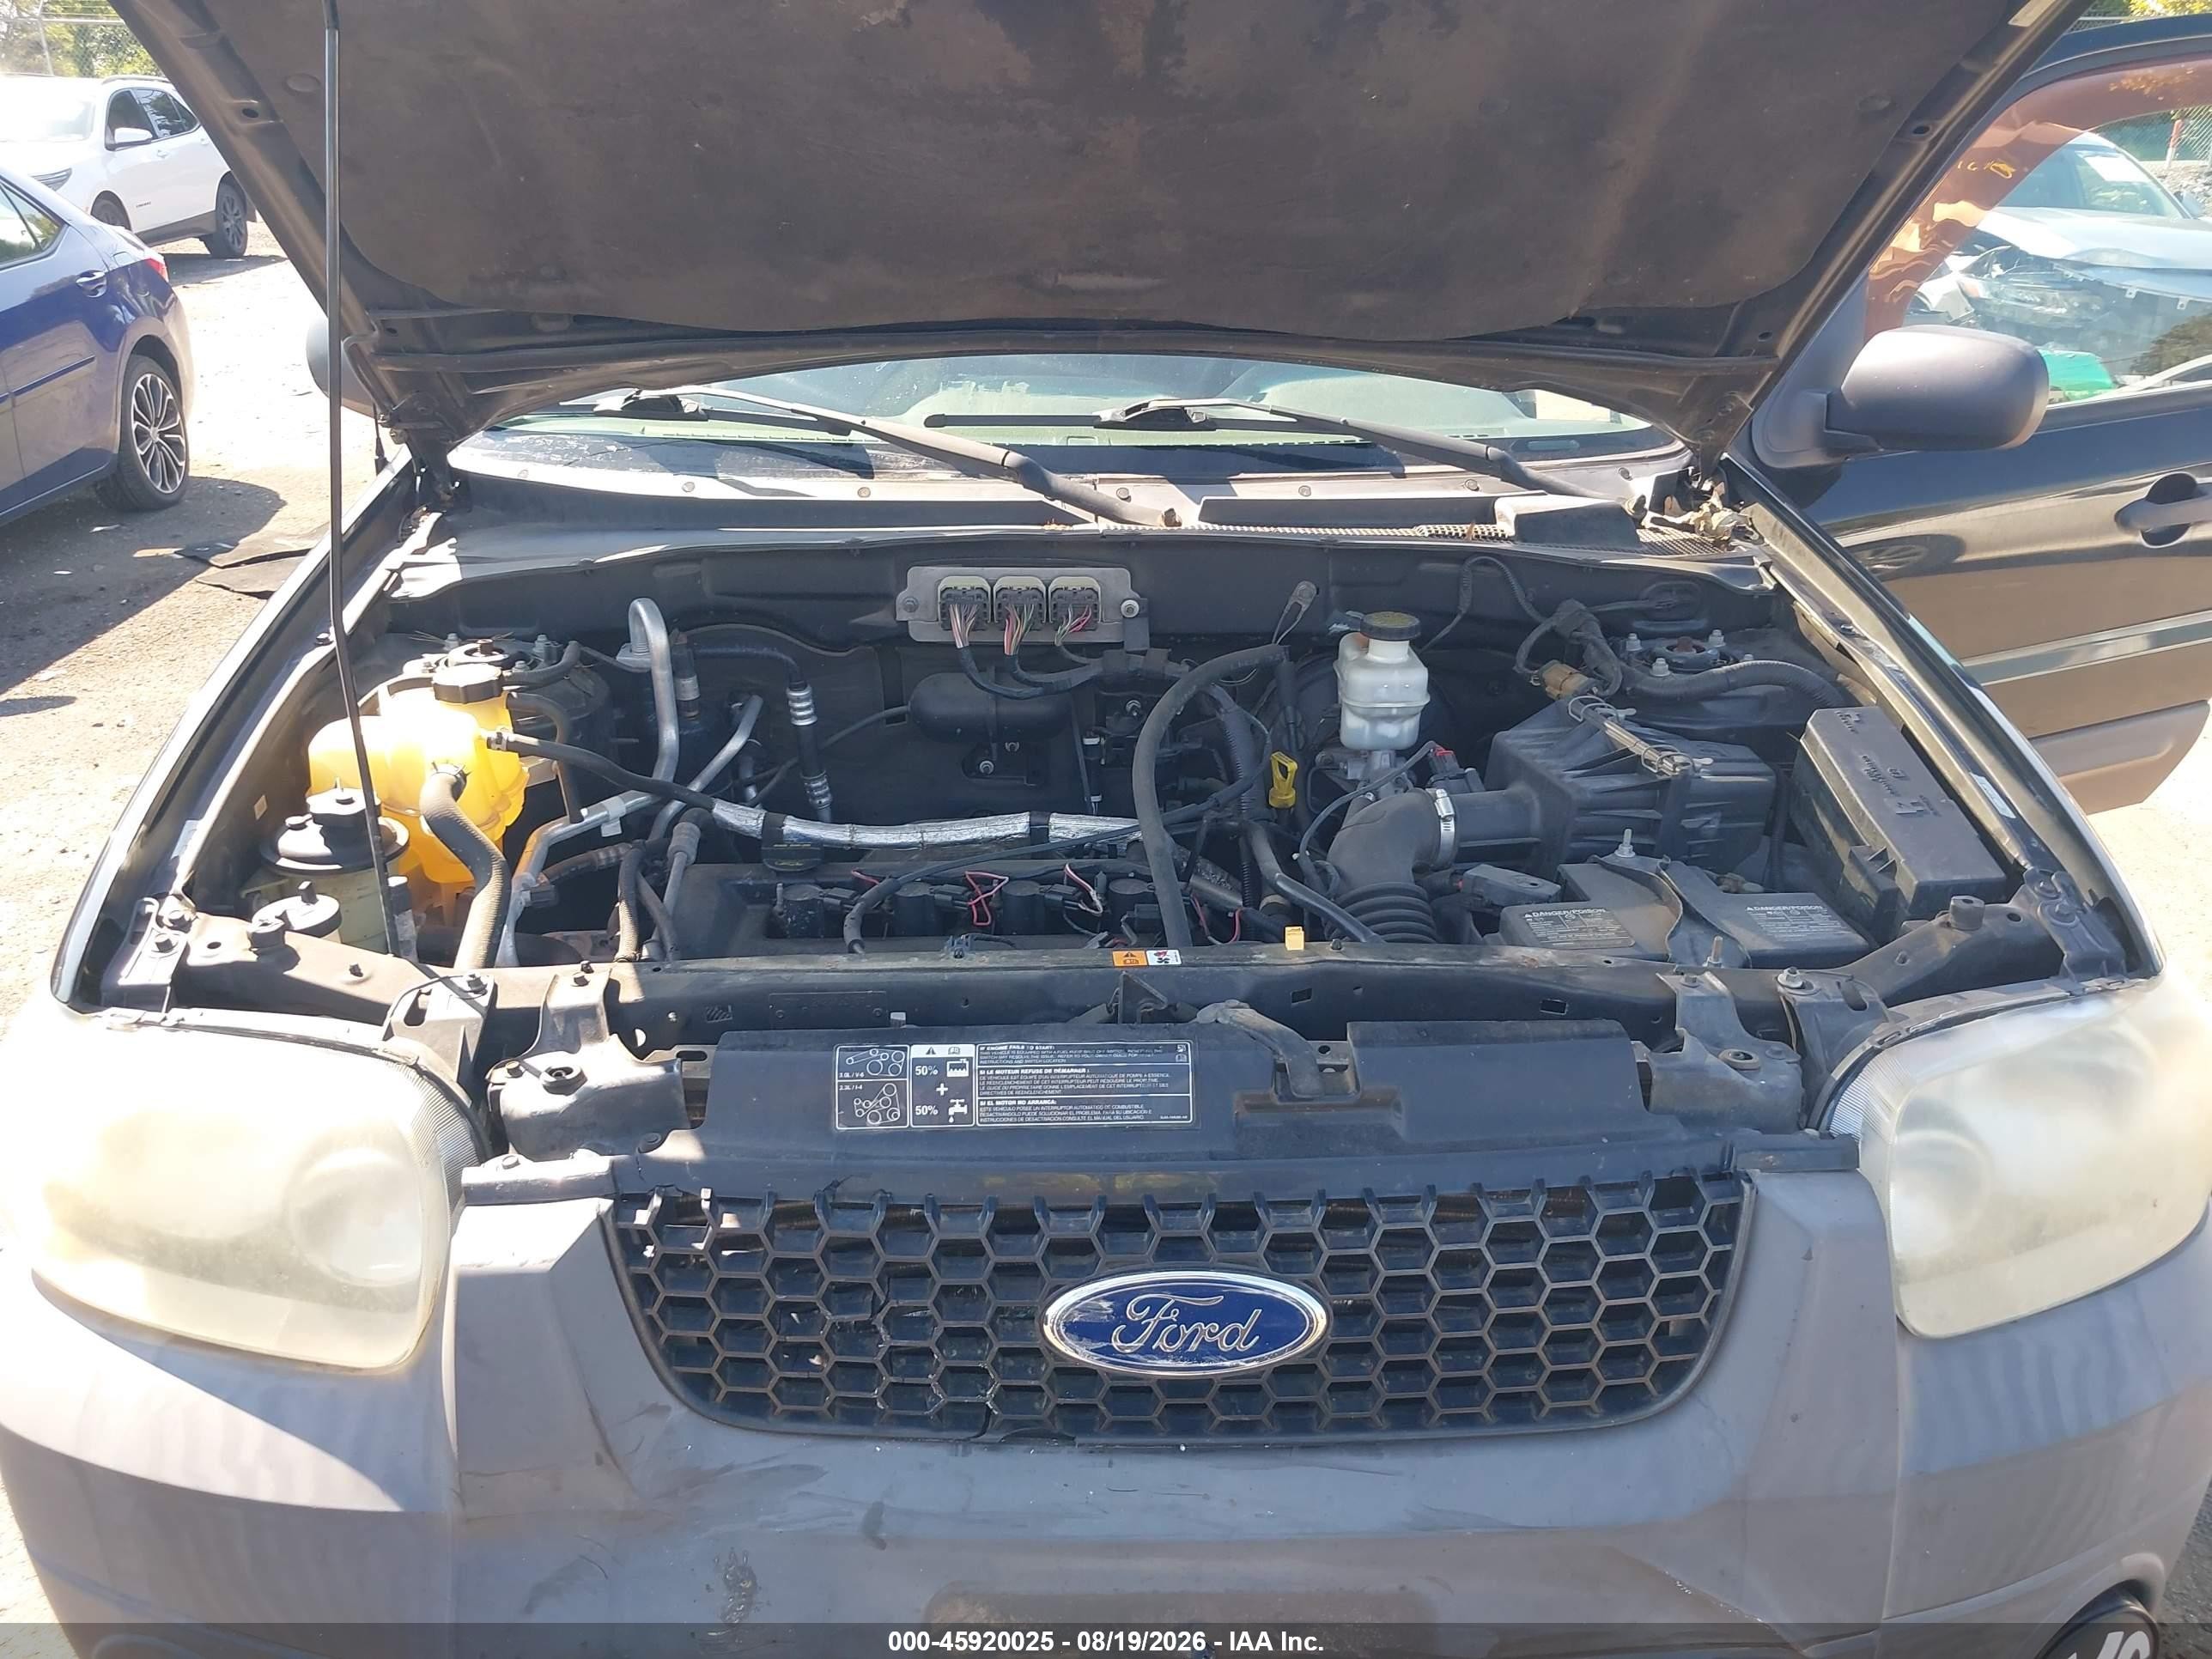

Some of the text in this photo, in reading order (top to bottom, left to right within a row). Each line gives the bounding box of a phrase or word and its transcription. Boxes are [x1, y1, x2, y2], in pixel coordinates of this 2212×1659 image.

[915, 1066, 939, 1076] 50%
[915, 1105, 939, 1115] 50%
[1111, 1293, 1263, 1353] Ford
